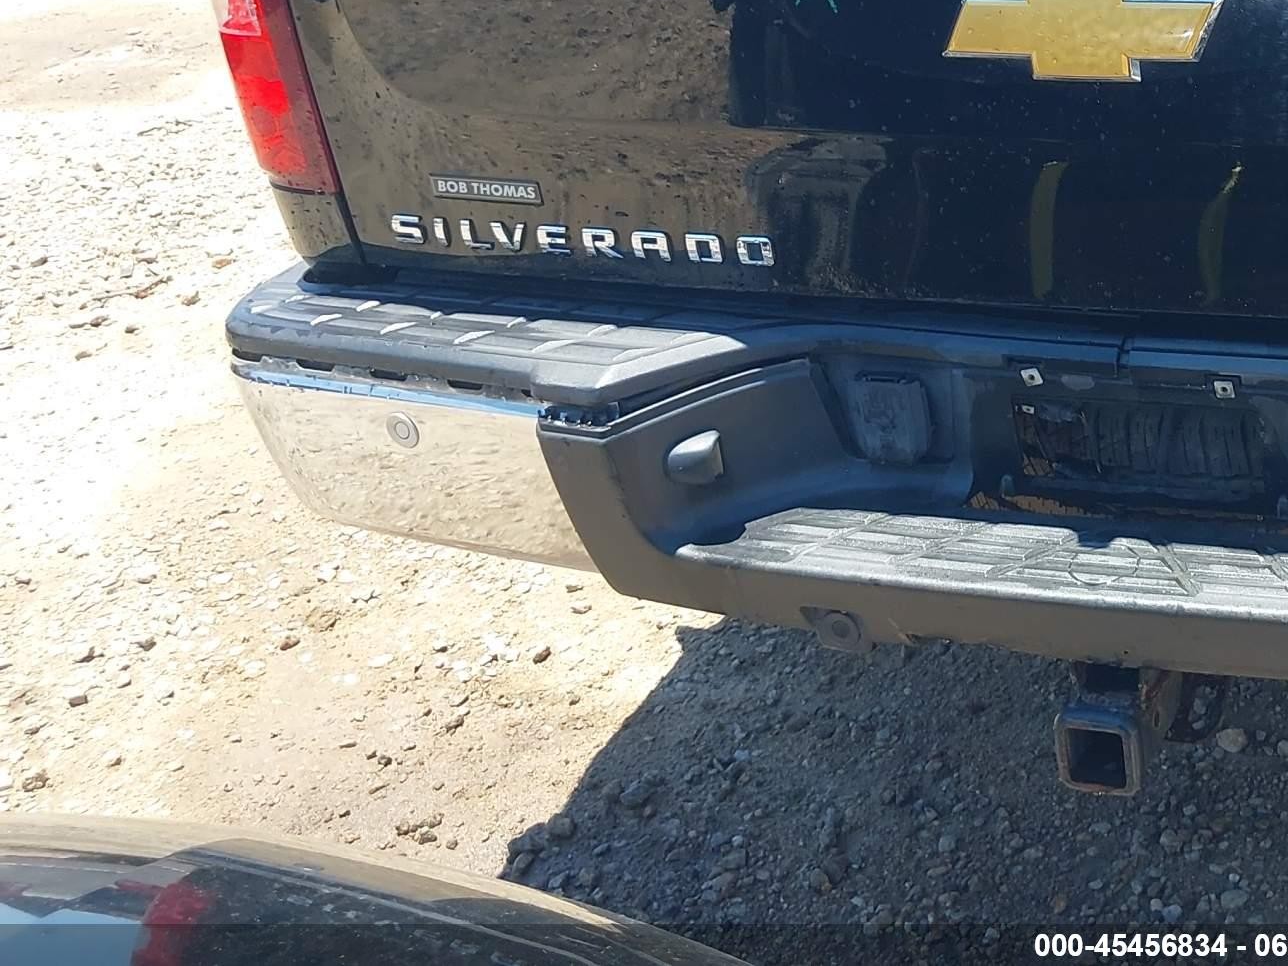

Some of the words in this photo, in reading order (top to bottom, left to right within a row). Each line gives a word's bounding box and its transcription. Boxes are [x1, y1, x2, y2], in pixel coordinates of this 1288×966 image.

[437, 180, 468, 194] BOB
[469, 182, 537, 200] THOMAS
[390, 213, 776, 268] SILVERADO
